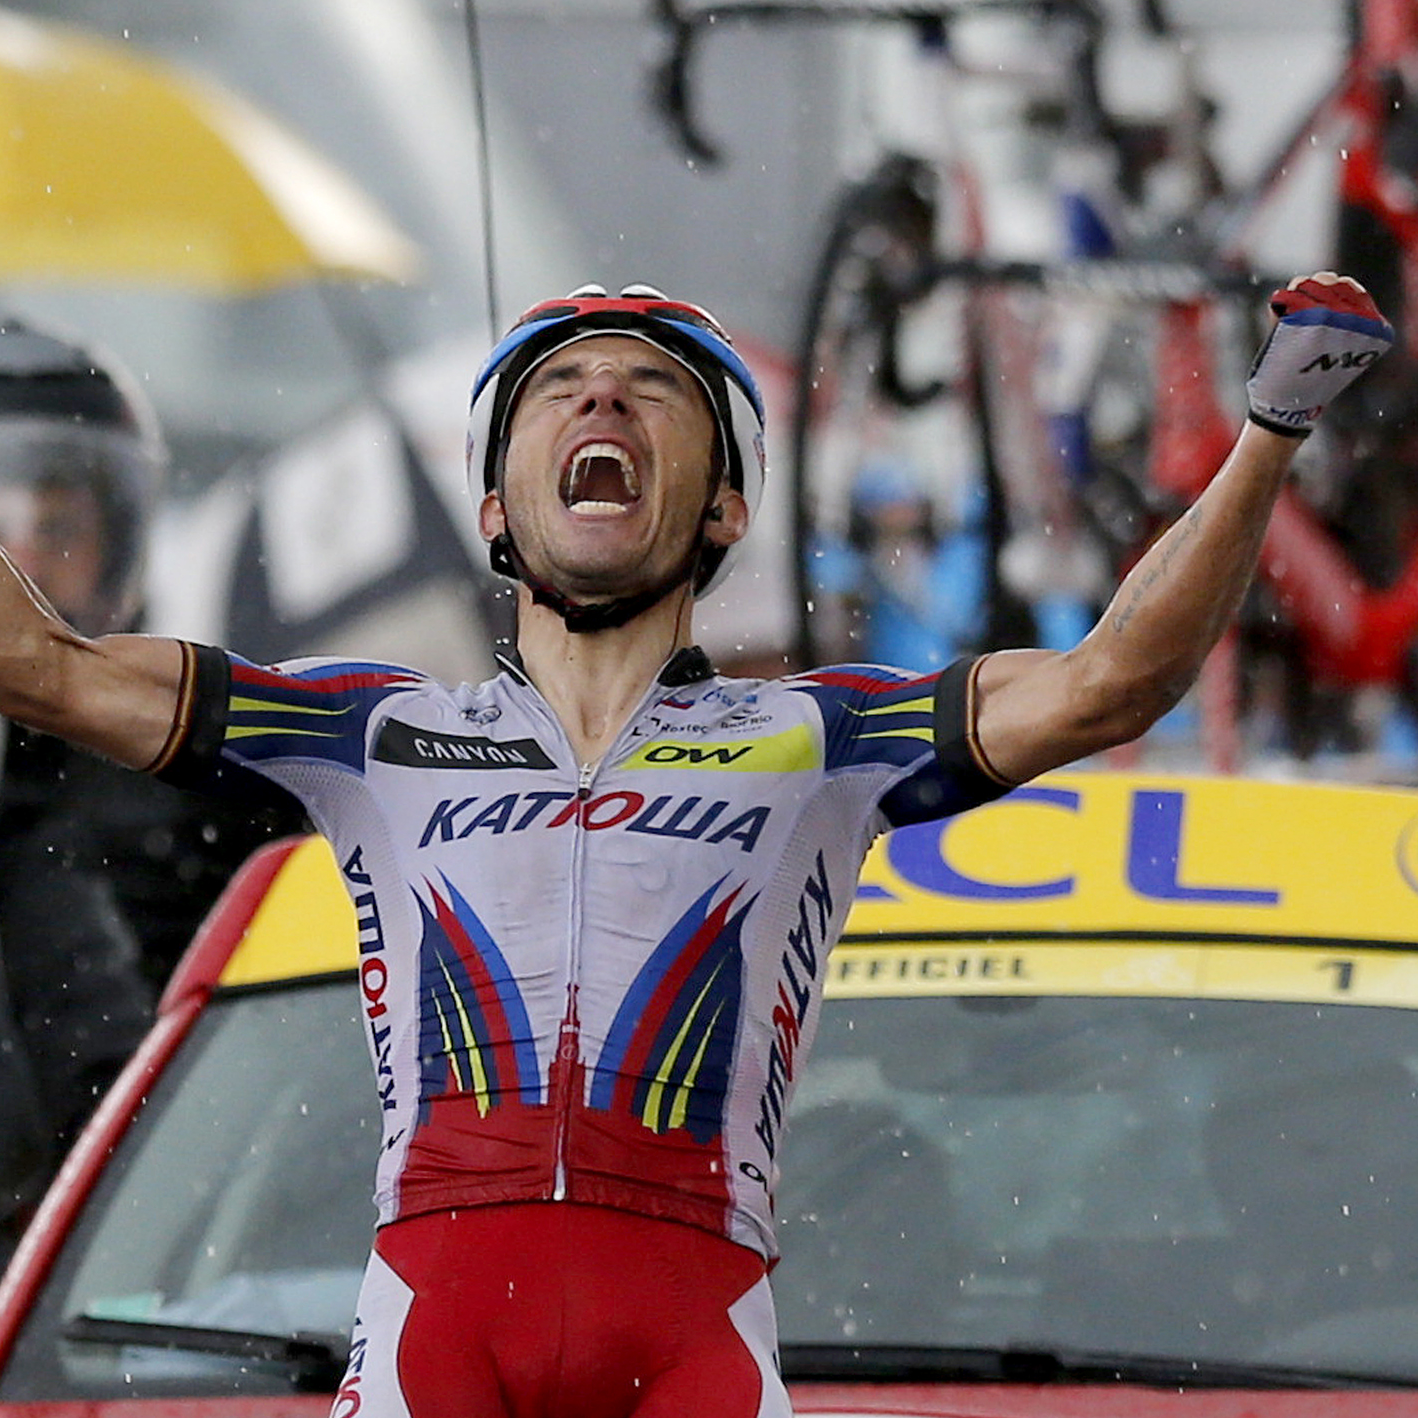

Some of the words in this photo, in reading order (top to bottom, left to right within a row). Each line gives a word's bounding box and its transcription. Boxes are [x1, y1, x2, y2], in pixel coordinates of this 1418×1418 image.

[414, 738, 528, 765] CANYON
[644, 745, 754, 764] OW
[1317, 960, 1355, 990] 1
